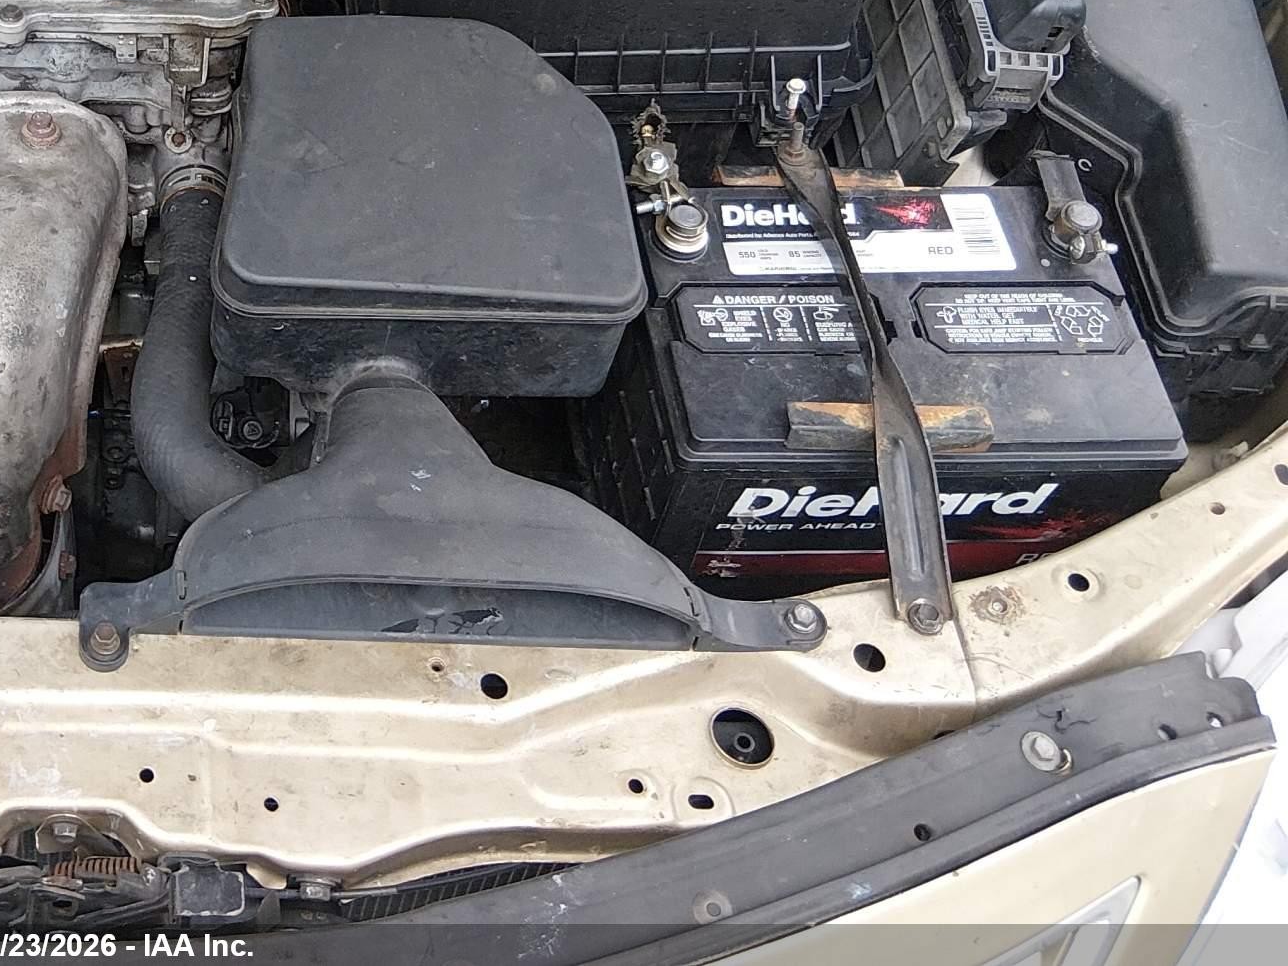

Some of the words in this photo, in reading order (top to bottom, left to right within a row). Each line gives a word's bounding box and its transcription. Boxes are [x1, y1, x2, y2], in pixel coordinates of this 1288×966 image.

[928, 246, 954, 255] RED
[725, 295, 777, 305] DANGER
[788, 294, 835, 304] POISON
[715, 523, 794, 531] POWER
[799, 522, 875, 531] AHEAD
